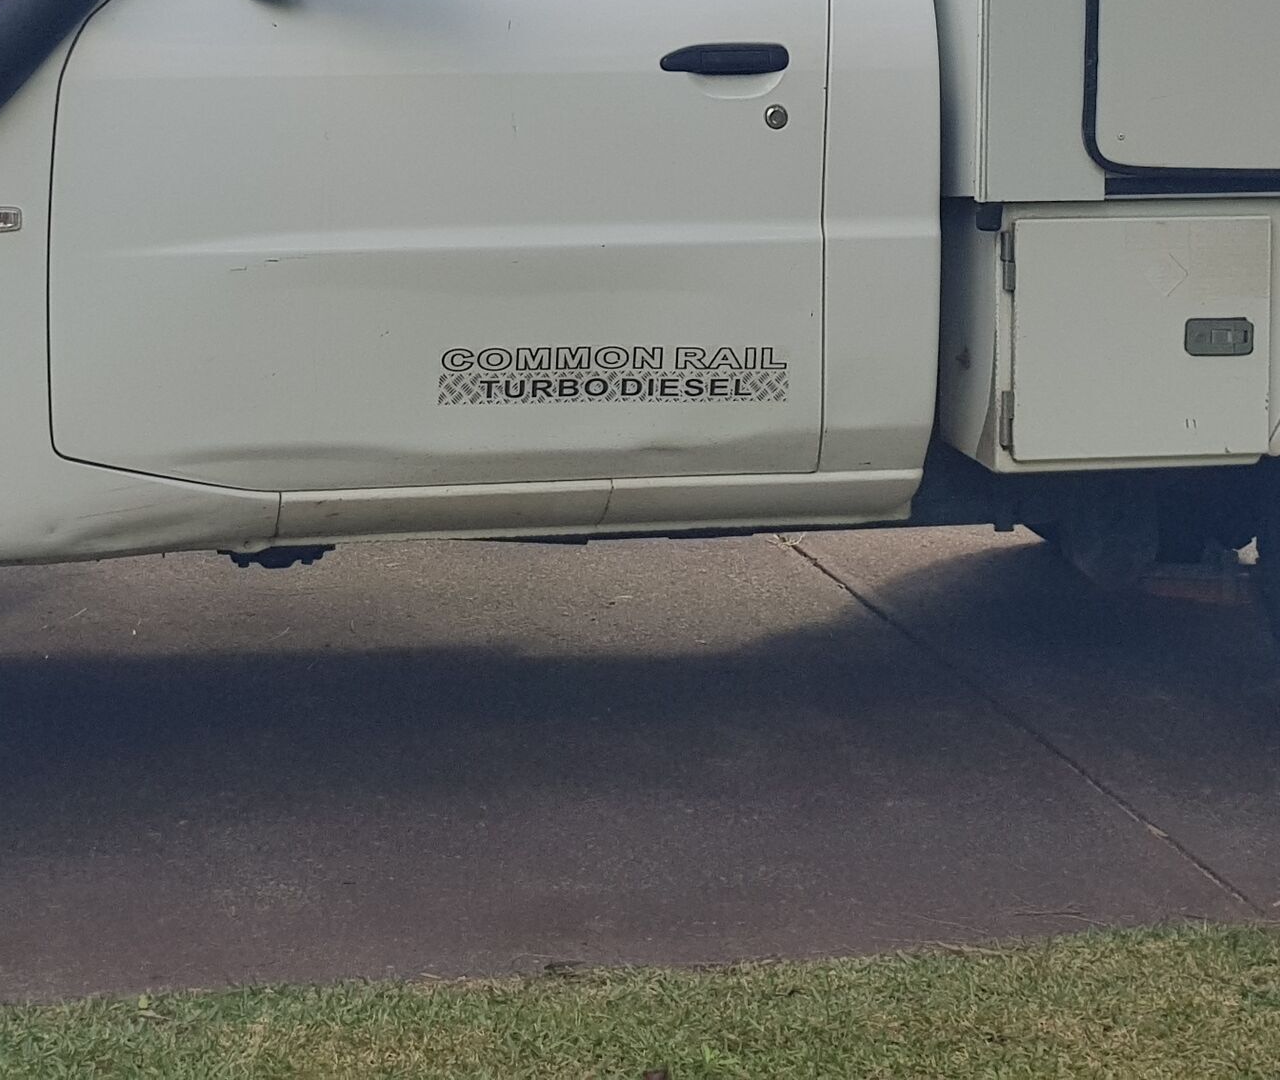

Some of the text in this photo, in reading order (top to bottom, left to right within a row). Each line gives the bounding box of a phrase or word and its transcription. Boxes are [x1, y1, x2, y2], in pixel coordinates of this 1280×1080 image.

[441, 346, 788, 372] COMMON RAIL
[480, 377, 752, 399] TURBO DIESEL
